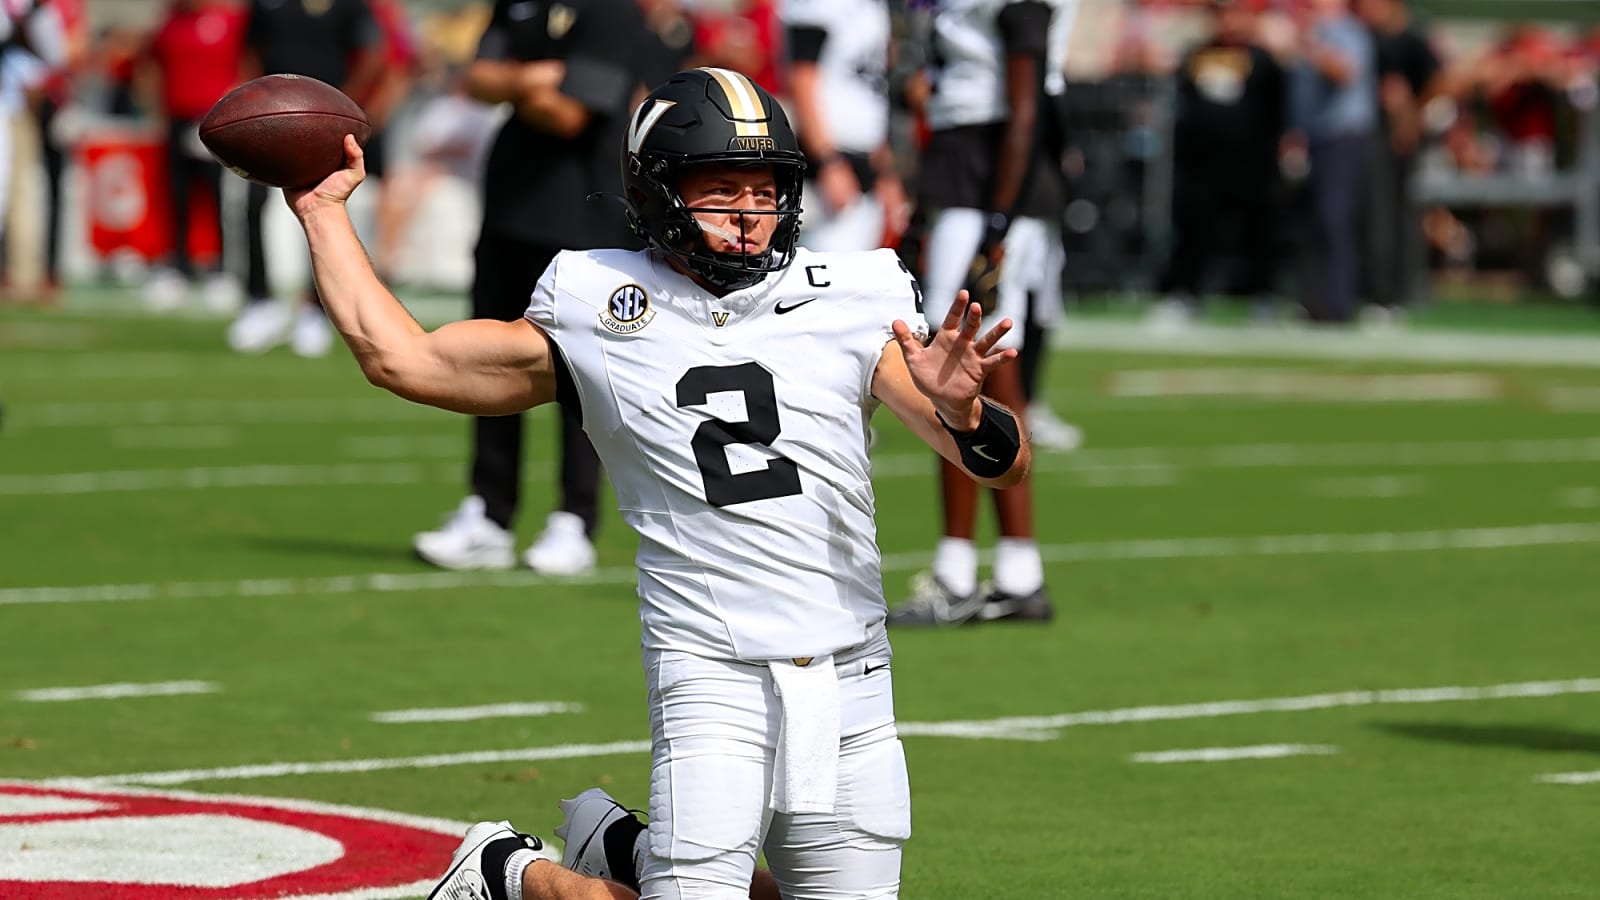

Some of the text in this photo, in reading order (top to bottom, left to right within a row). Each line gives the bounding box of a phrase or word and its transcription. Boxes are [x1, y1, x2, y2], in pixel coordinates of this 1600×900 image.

[628, 98, 677, 156] V
[736, 137, 774, 150] VUFB
[805, 265, 831, 287] C
[612, 286, 645, 321] SEC
[604, 317, 647, 332] GRADUATE
[711, 312, 729, 328] V
[675, 361, 803, 508] 2
